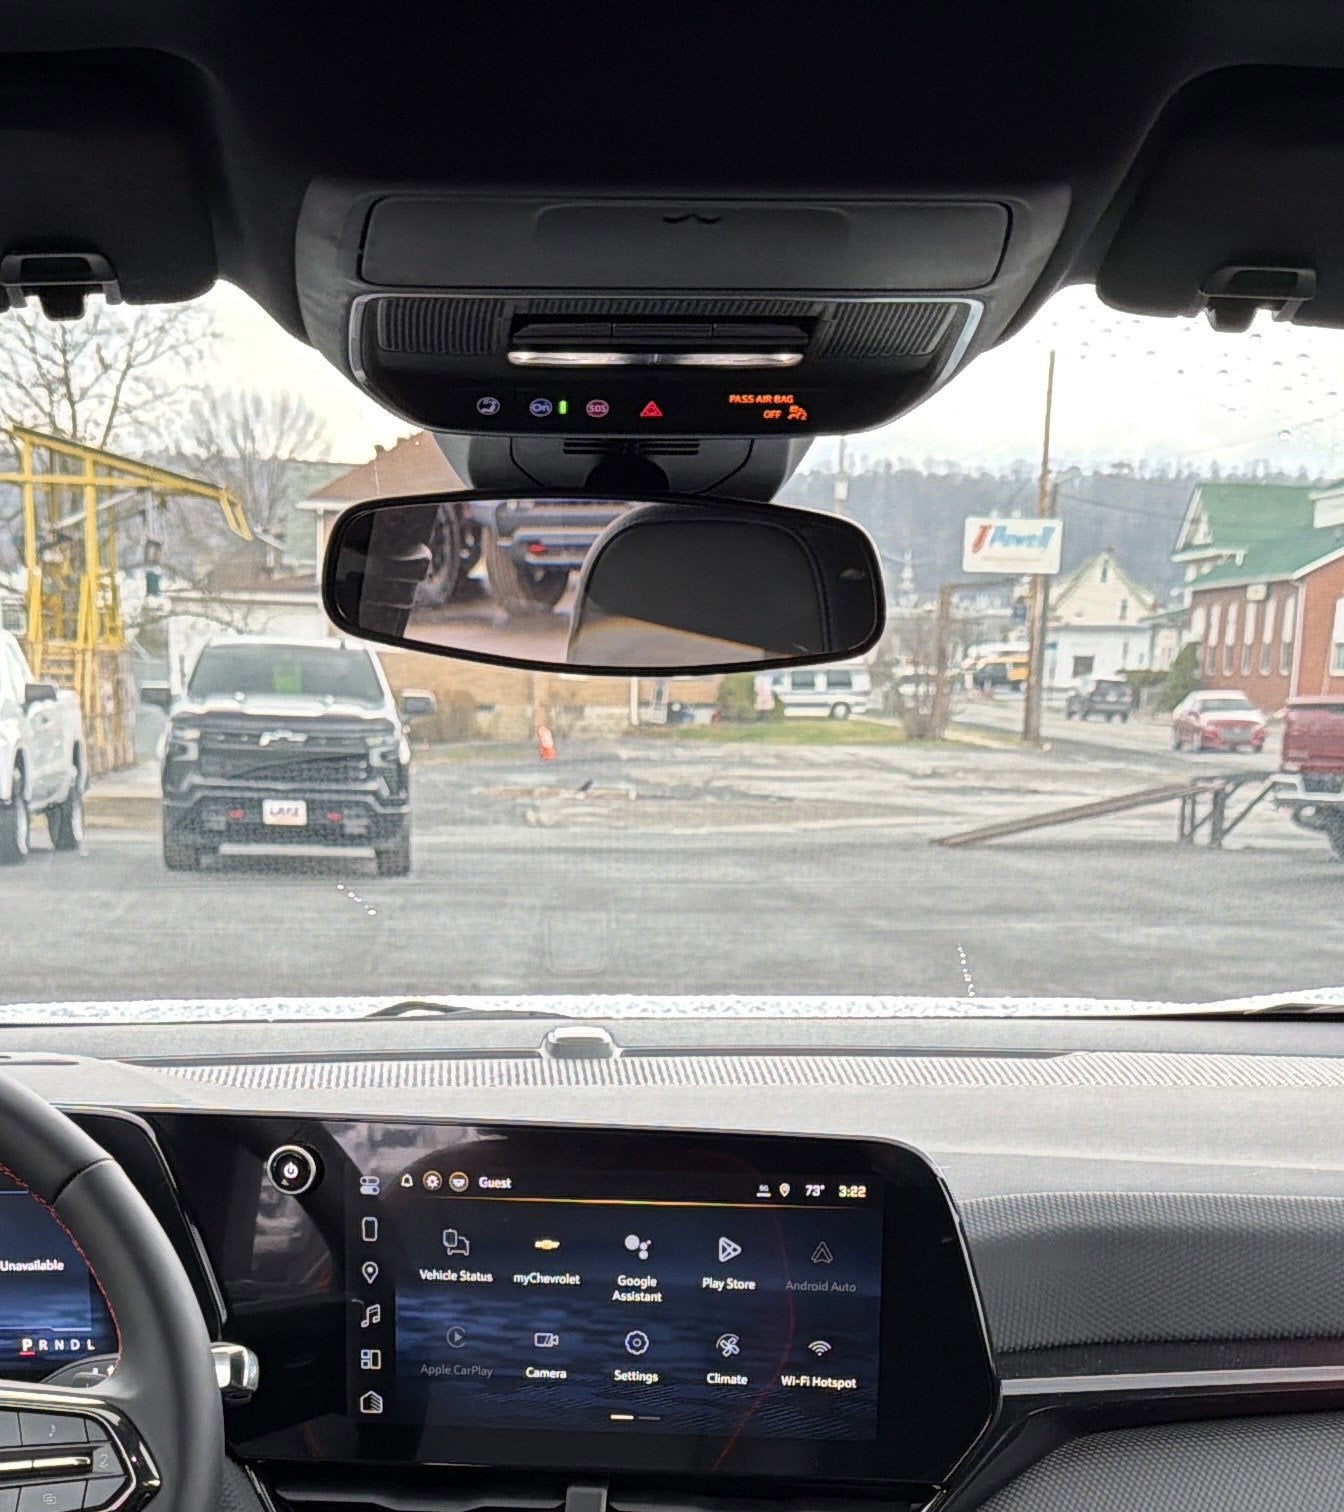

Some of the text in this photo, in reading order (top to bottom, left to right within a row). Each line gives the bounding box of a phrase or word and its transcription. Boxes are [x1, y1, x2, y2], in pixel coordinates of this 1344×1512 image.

[729, 394, 794, 404] PASS AIR BAG
[590, 404, 606, 413] SOS
[763, 409, 783, 419] OFF
[478, 1176, 512, 1189] Guest
[838, 1184, 867, 1198] 3:22
[0, 1259, 65, 1272] Unavailable
[419, 1268, 493, 1283] Vehicle Status
[513, 1272, 581, 1286] myChevrolet
[617, 1274, 658, 1289] Google
[702, 1277, 757, 1292] Play Store
[785, 1280, 856, 1293] Android Auto
[612, 1290, 663, 1303] Assistant
[22, 1338, 95, 1351] P R N D L
[420, 1364, 493, 1379] Apple CarPlay
[525, 1366, 567, 1379] Camera
[614, 1369, 659, 1384] Settings
[707, 1372, 748, 1385] Climate
[781, 1374, 857, 1390] Wi-Fi Hotspot
